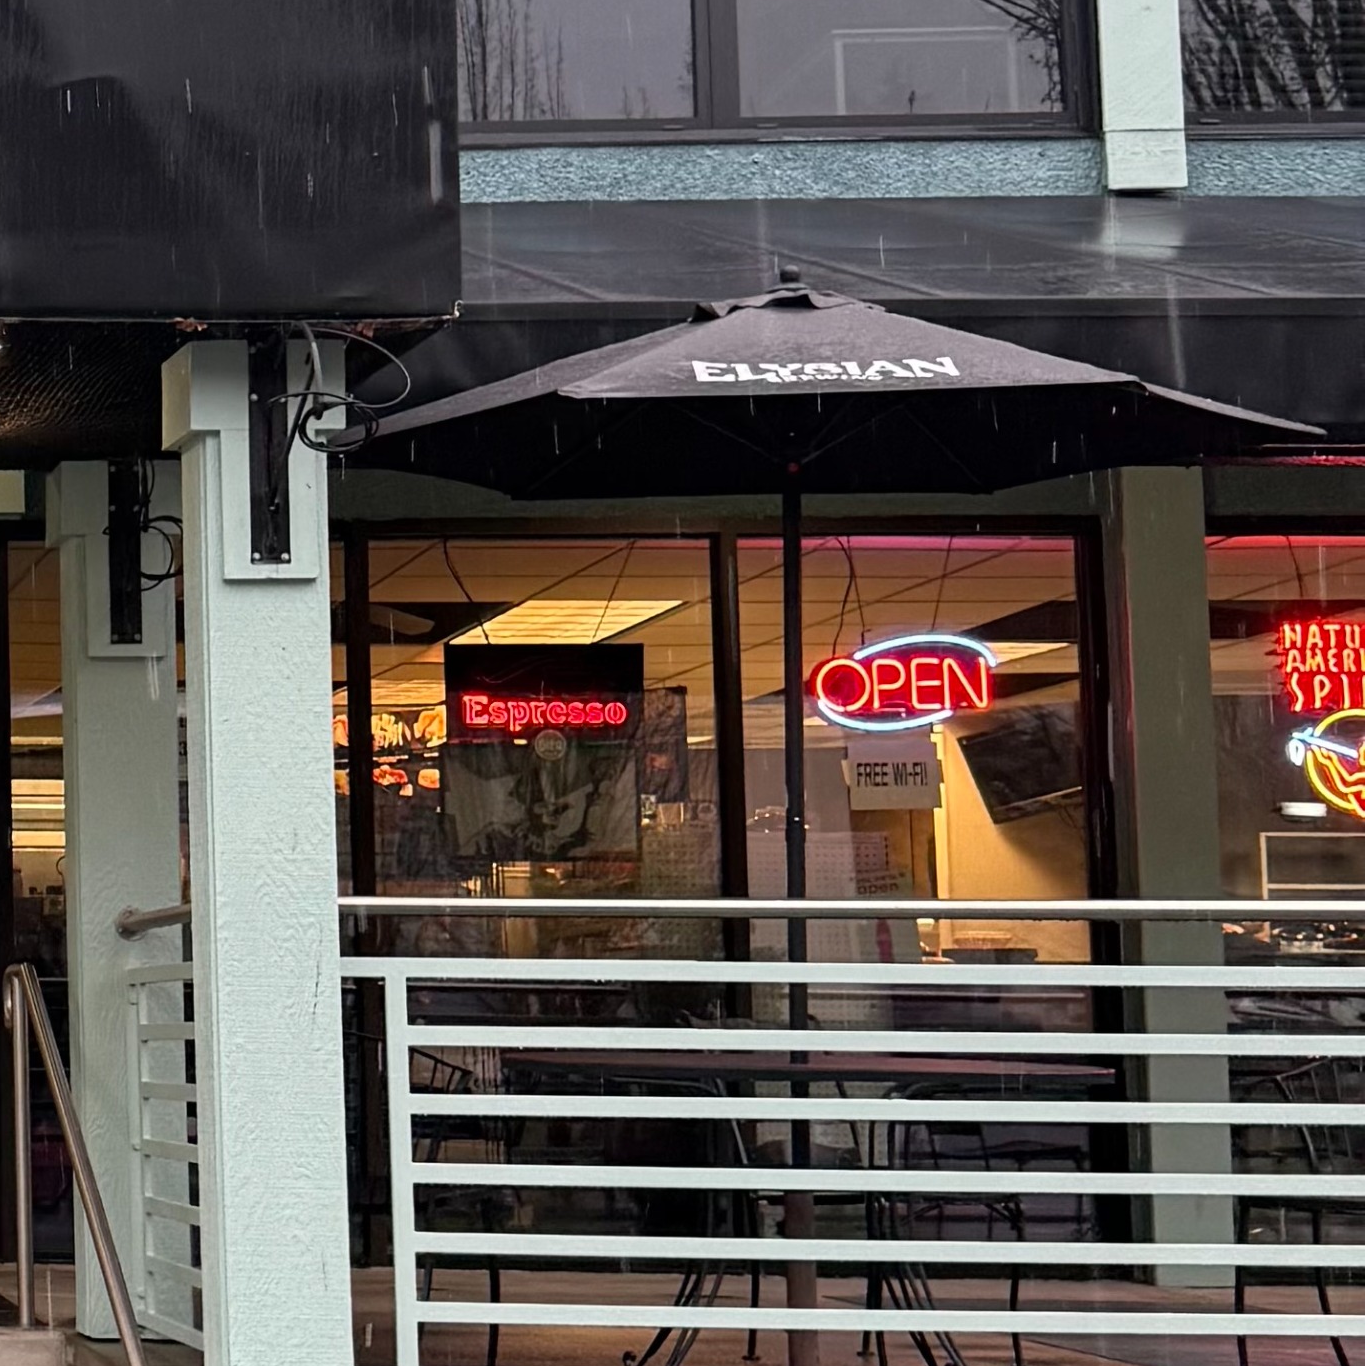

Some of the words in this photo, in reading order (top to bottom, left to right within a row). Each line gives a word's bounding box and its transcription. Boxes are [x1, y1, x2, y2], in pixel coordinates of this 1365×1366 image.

[692, 356, 961, 383] ELYSIAN
[816, 656, 989, 712] OPEN
[462, 695, 627, 732] Espresso
[856, 762, 889, 787] FREE
[892, 762, 928, 786] WI-FI!
